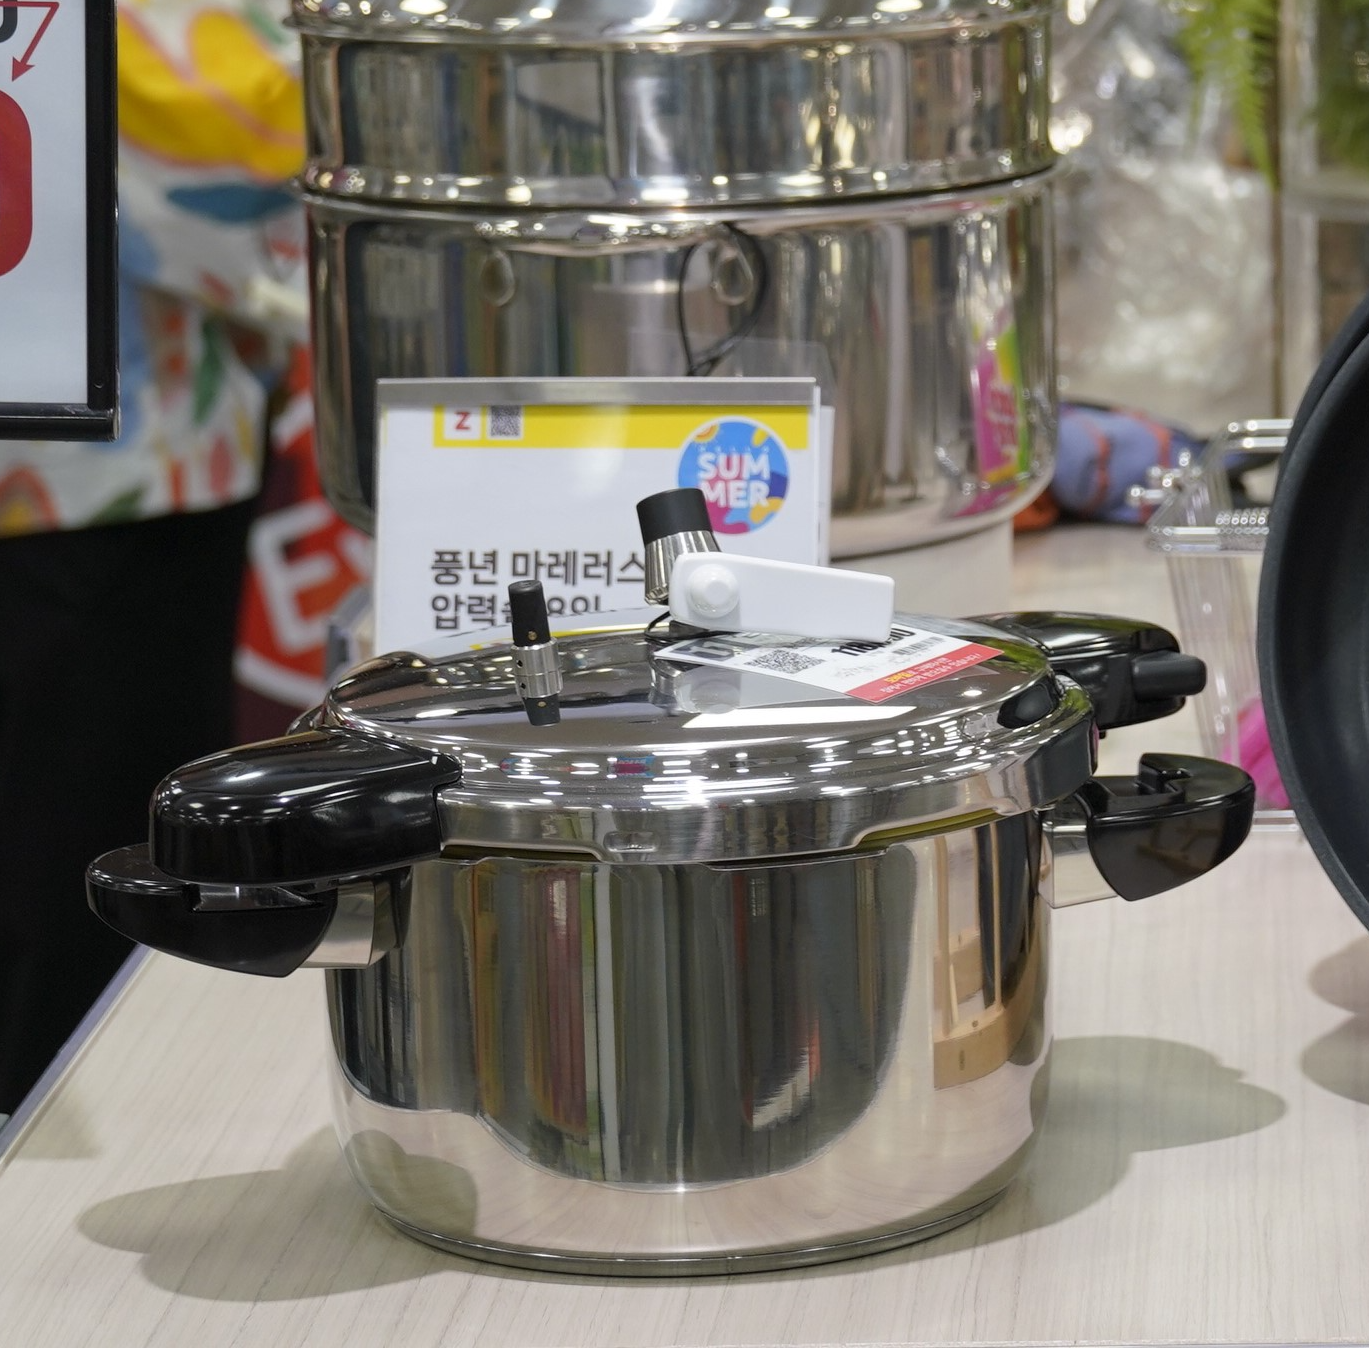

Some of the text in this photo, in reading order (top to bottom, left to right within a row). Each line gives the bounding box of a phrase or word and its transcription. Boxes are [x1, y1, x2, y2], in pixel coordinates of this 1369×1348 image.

[697, 452, 770, 481] SUM
[701, 480, 770, 508] MER
[431, 549, 498, 586] 풍년
